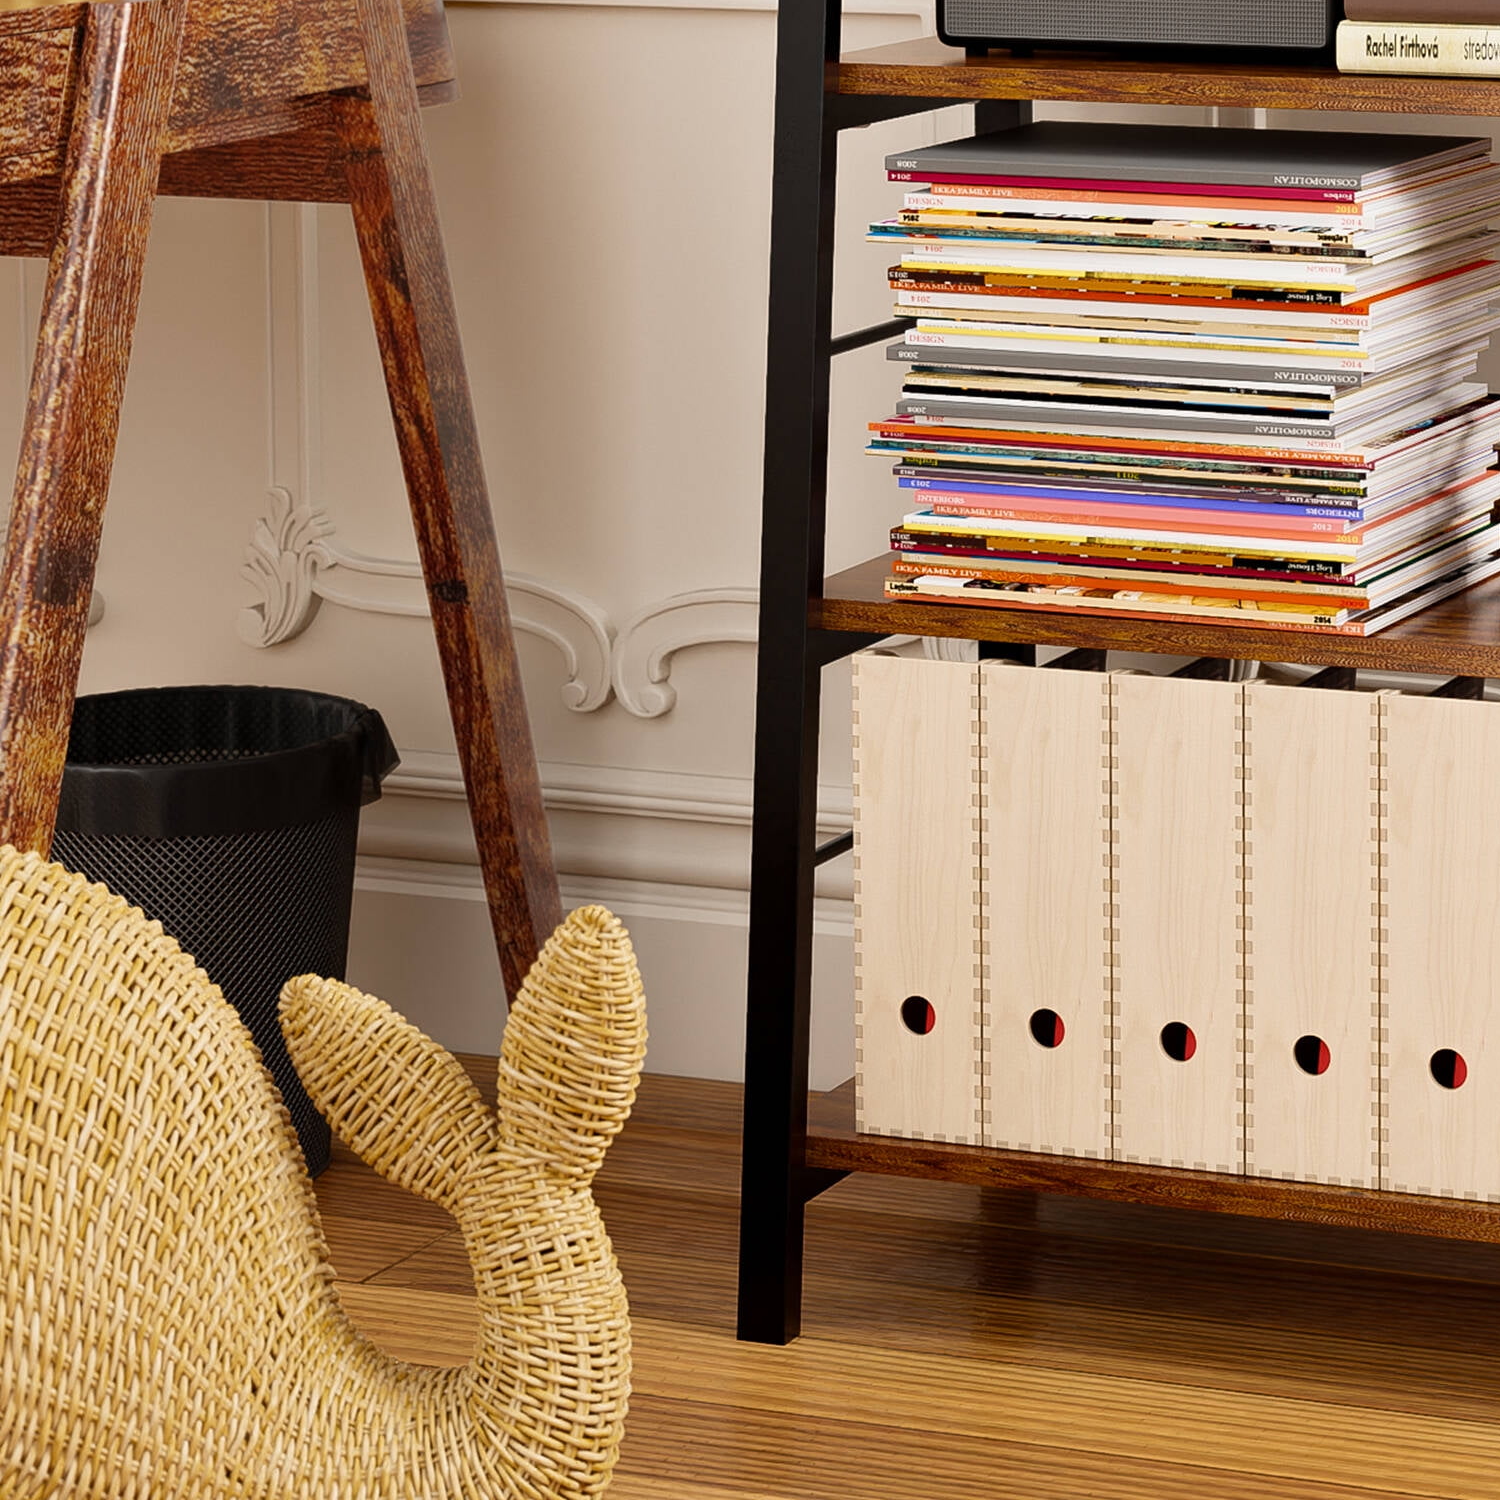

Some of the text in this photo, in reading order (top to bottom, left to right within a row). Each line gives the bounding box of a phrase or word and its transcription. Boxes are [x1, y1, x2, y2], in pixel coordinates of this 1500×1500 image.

[1365, 33, 1439, 59] Rachel Firthová
[896, 160, 917, 169] 2008
[891, 173, 911, 181] 2014
[1274, 175, 1358, 188] COSMOPOLITAN
[934, 186, 1013, 197] IKEA FAMILY LIVE
[1323, 192, 1353, 200] Forbes
[908, 196, 944, 206] DESIGN
[1335, 205, 1358, 214] 2010
[1341, 217, 1362, 226] 2014
[925, 245, 943, 253] 2014
[1307, 266, 1341, 274] DESIGN
[893, 280, 981, 292] IKEA FAMILY LIVE
[911, 295, 931, 303] 2014
[1330, 317, 1369, 327] DESIGN
[909, 334, 945, 344] DESIGN
[898, 350, 919, 359] 2008
[1341, 360, 1362, 369] 2014
[1274, 371, 1358, 384] COSMOPOLITAN
[907, 406, 926, 414] 2008
[1254, 425, 1332, 438] COSMOPOLITAN
[1307, 440, 1342, 449] DESIGN
[1264, 450, 1360, 463] IKEA FAMILY LIVE
[1329, 485, 1364, 496] Forbes
[917, 494, 965, 504] INTERIORS
[936, 505, 1015, 517] IKEA FAMILY LIVE
[1305, 507, 1360, 518] INTERIORS
[1336, 535, 1358, 543] 2010
[895, 564, 983, 577] IKEA FAMILY LIVE
[1288, 563, 1333, 573] Log House
